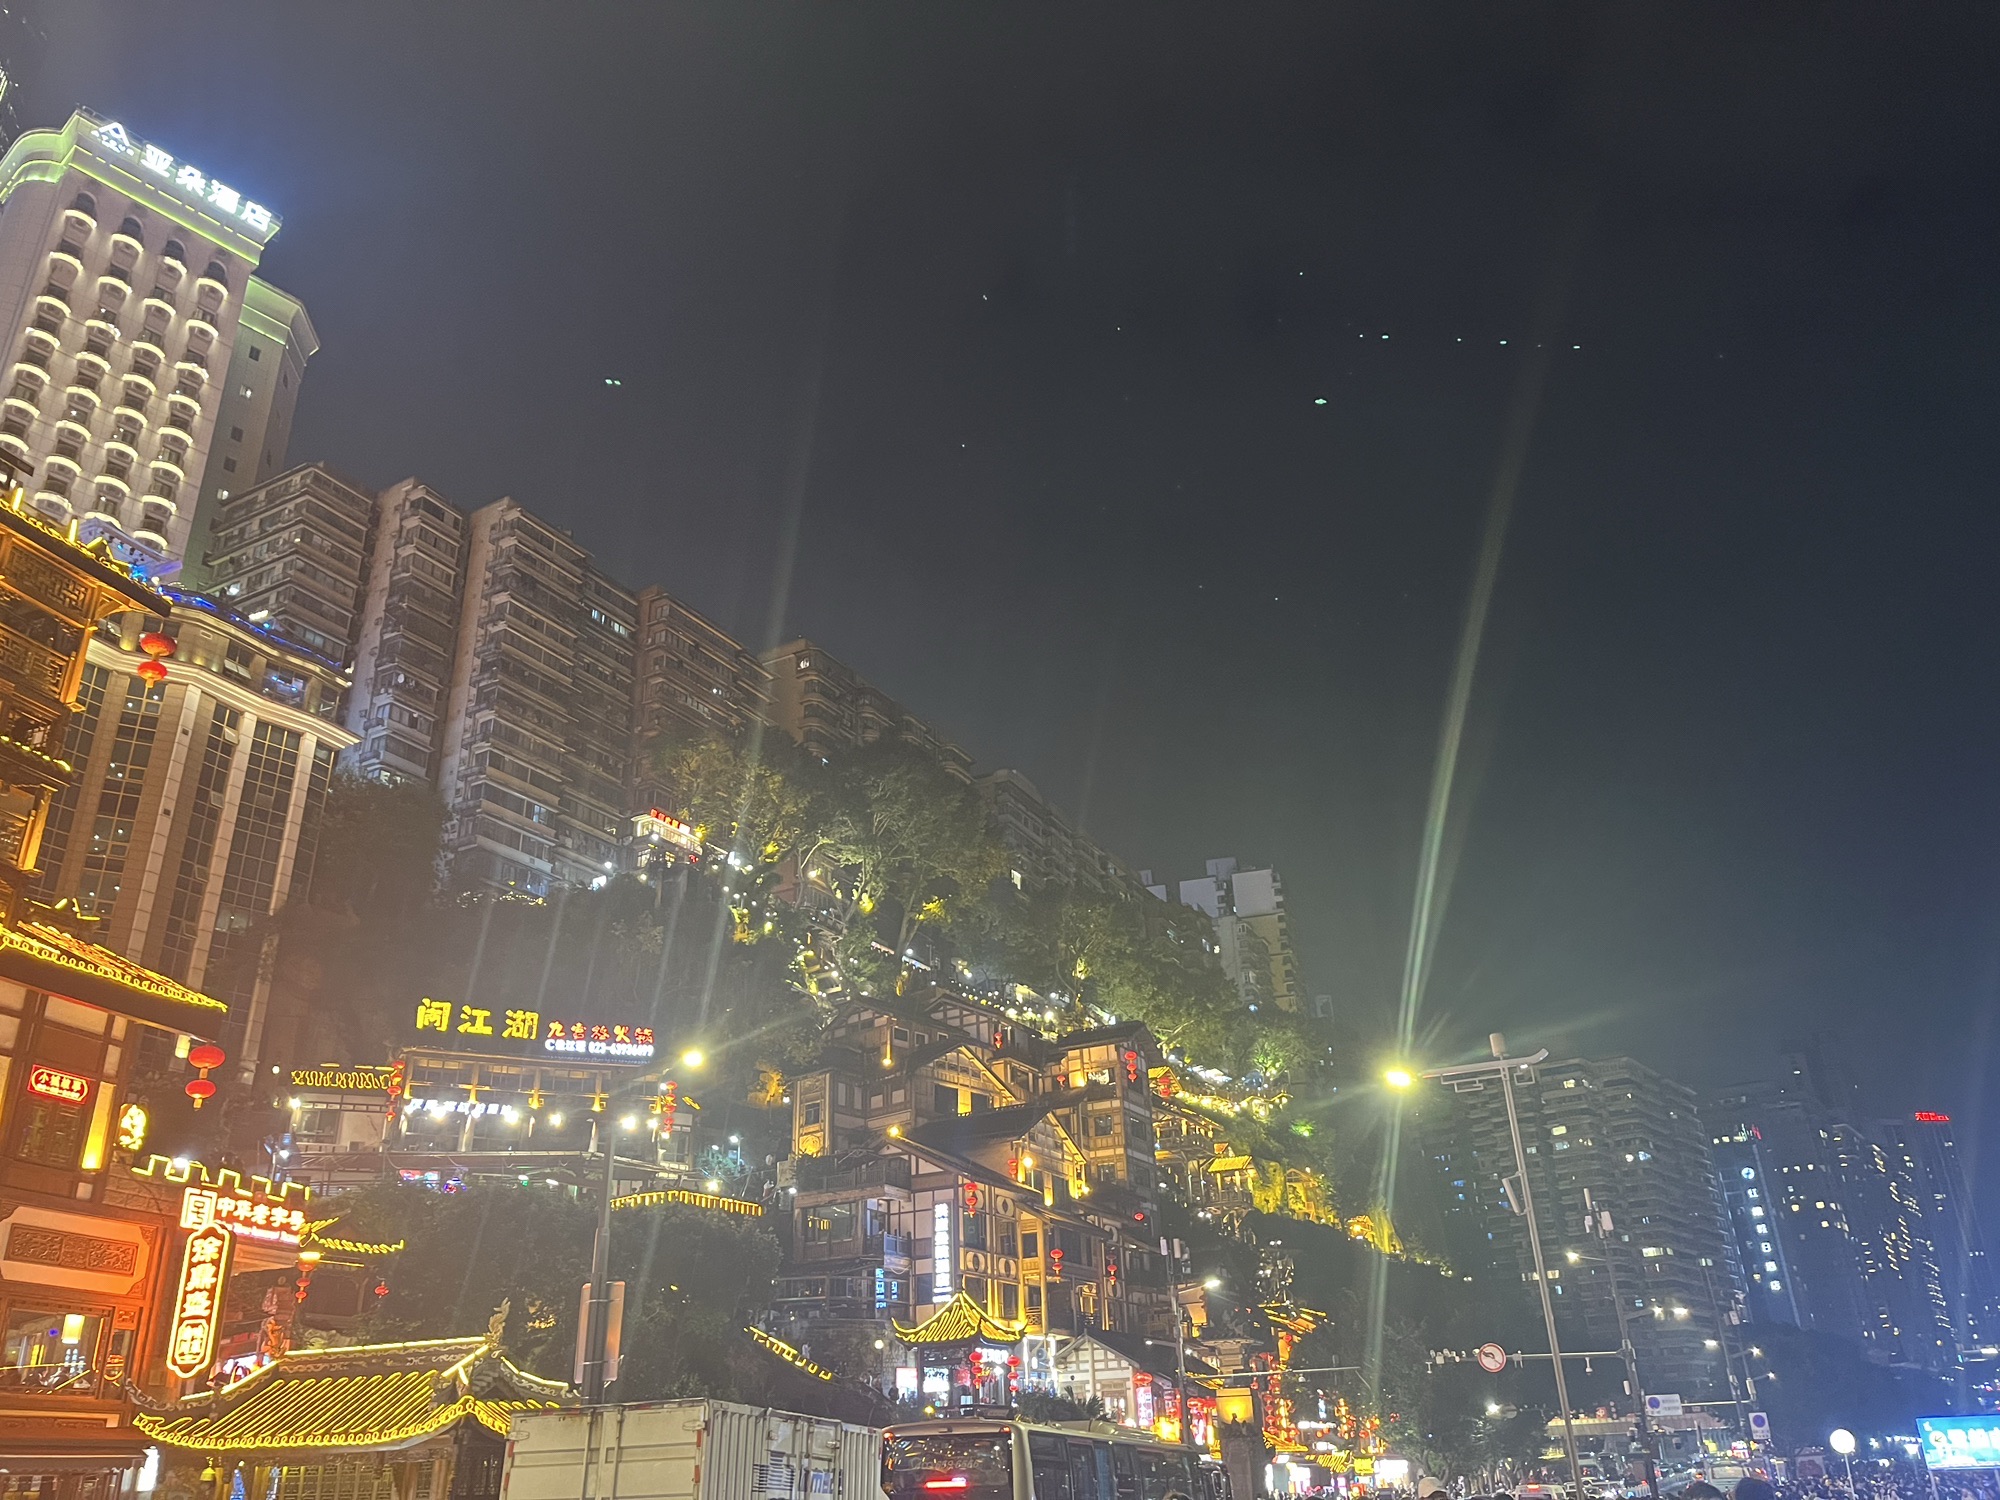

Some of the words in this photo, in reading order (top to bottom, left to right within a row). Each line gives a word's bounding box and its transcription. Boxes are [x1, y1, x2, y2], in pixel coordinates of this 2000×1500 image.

[141, 143, 273, 232] 亚朵酒店
[416, 998, 539, 1040] 闹江湖
[216, 1197, 306, 1231] 中华老字号
